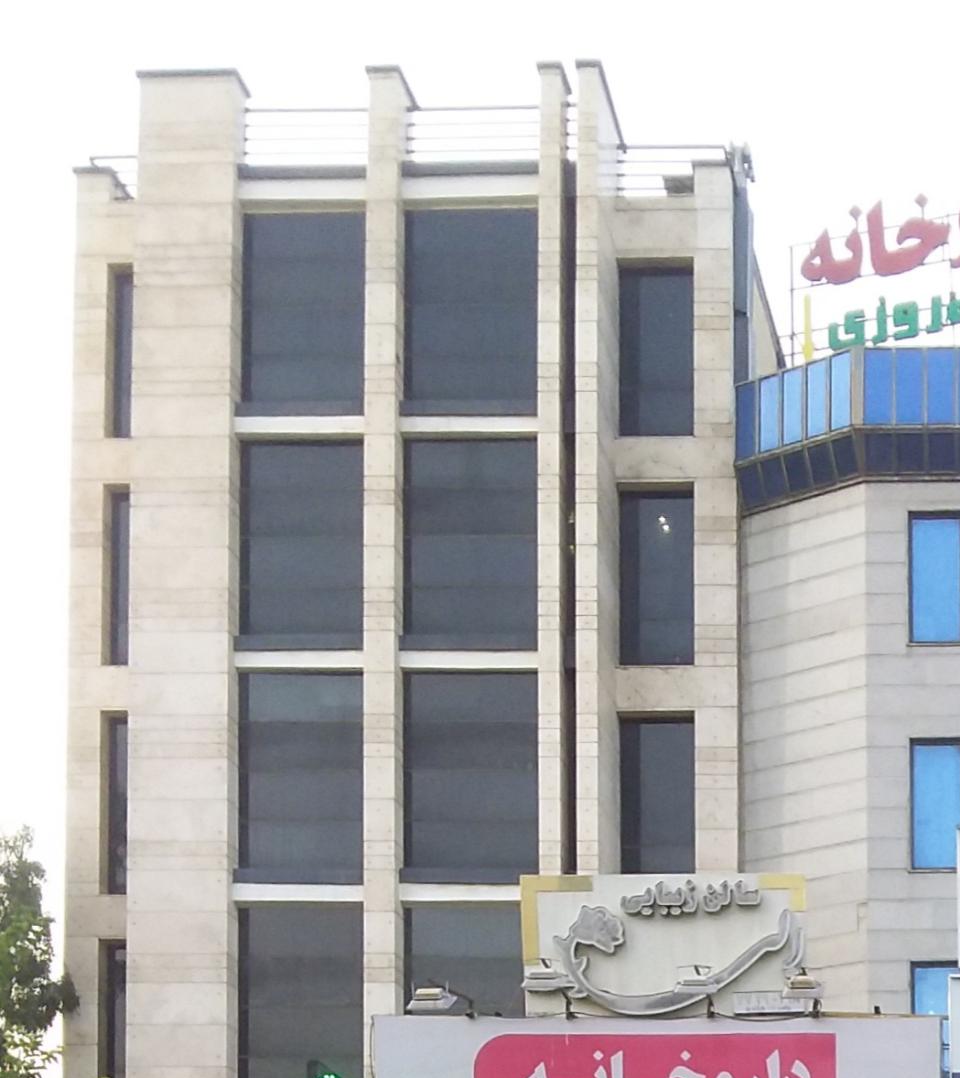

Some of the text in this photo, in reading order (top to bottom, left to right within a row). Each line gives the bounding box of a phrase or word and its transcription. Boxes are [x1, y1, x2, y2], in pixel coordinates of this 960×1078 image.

[828, 295, 942, 351] روزی
[621, 879, 760, 917] سالن زیبایی
